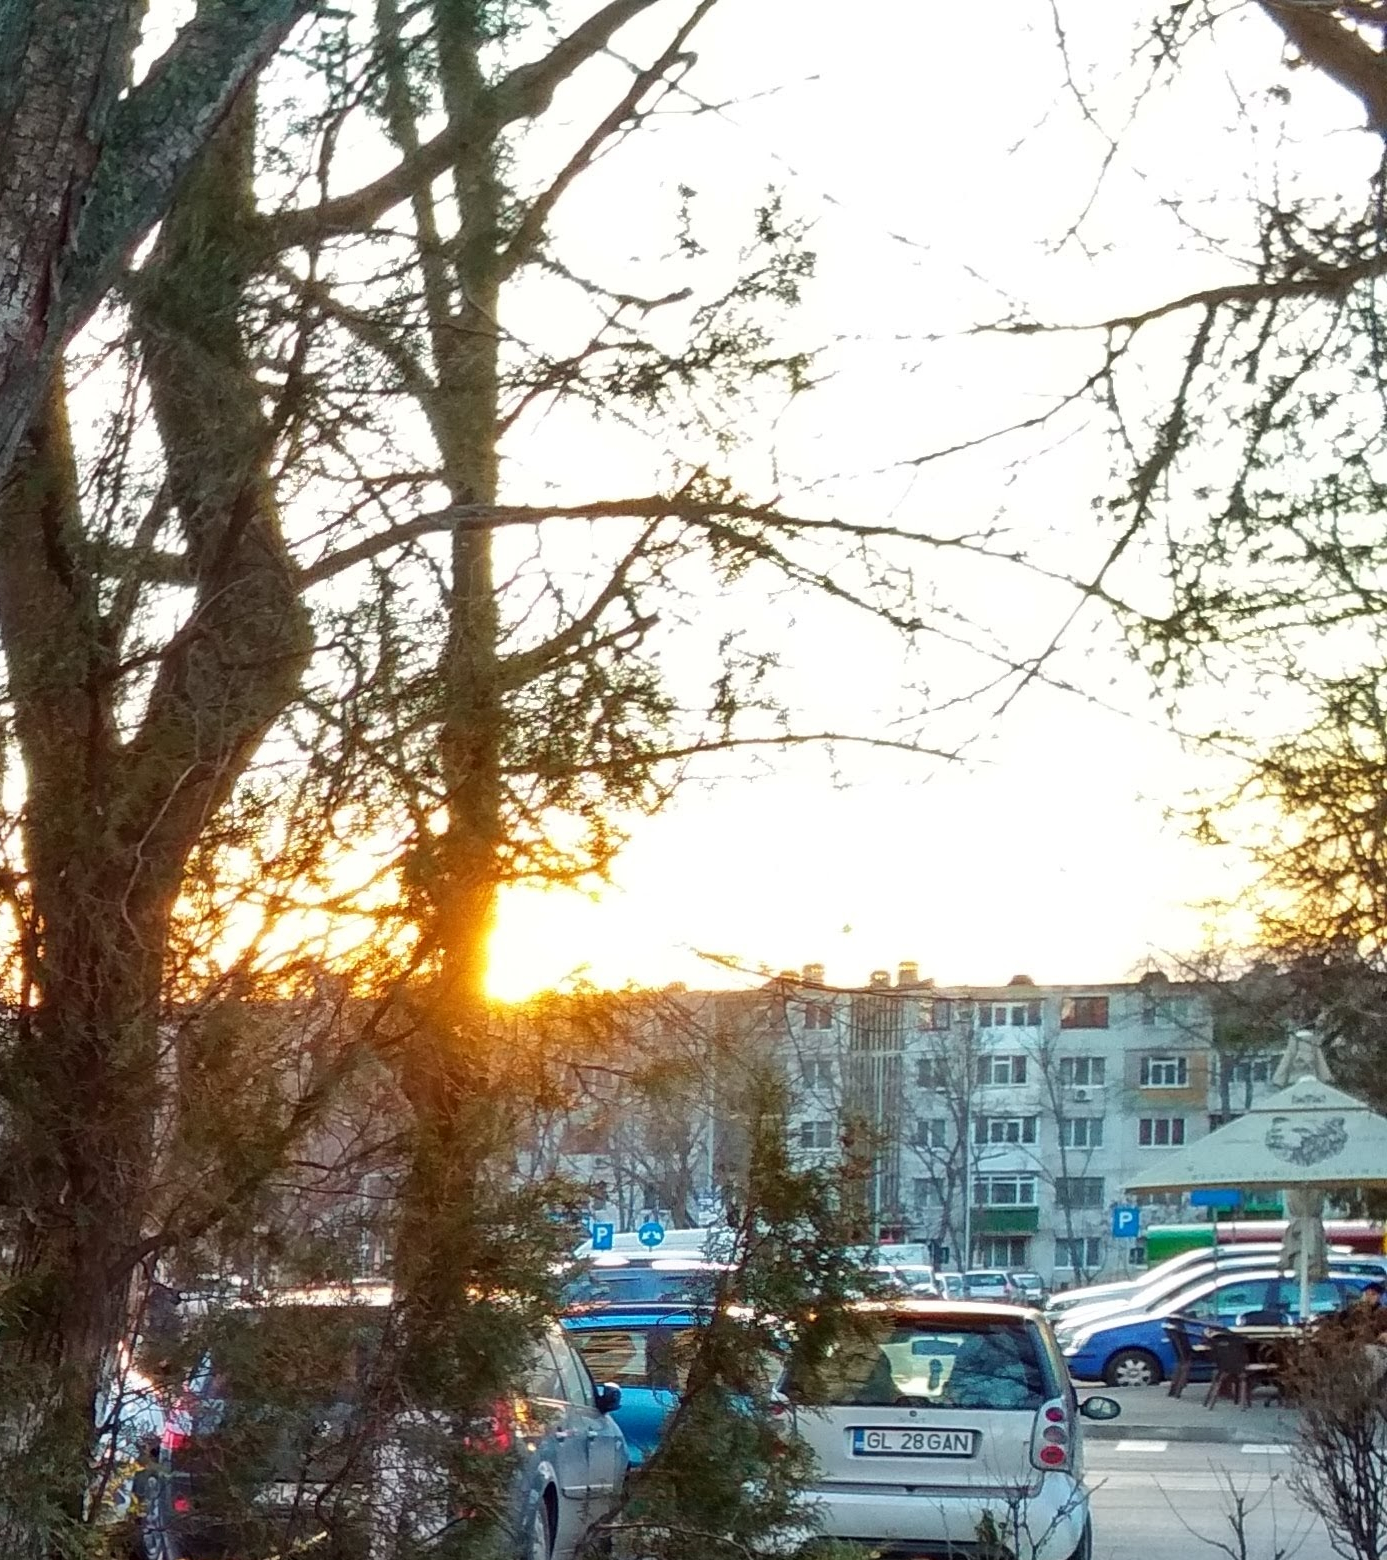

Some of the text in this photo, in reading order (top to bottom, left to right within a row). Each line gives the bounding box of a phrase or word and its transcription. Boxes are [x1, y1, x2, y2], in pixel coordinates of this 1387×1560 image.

[1119, 1211, 1133, 1229] P
[596, 1226, 608, 1243] P
[867, 1432, 969, 1451] GL 28 GAN
